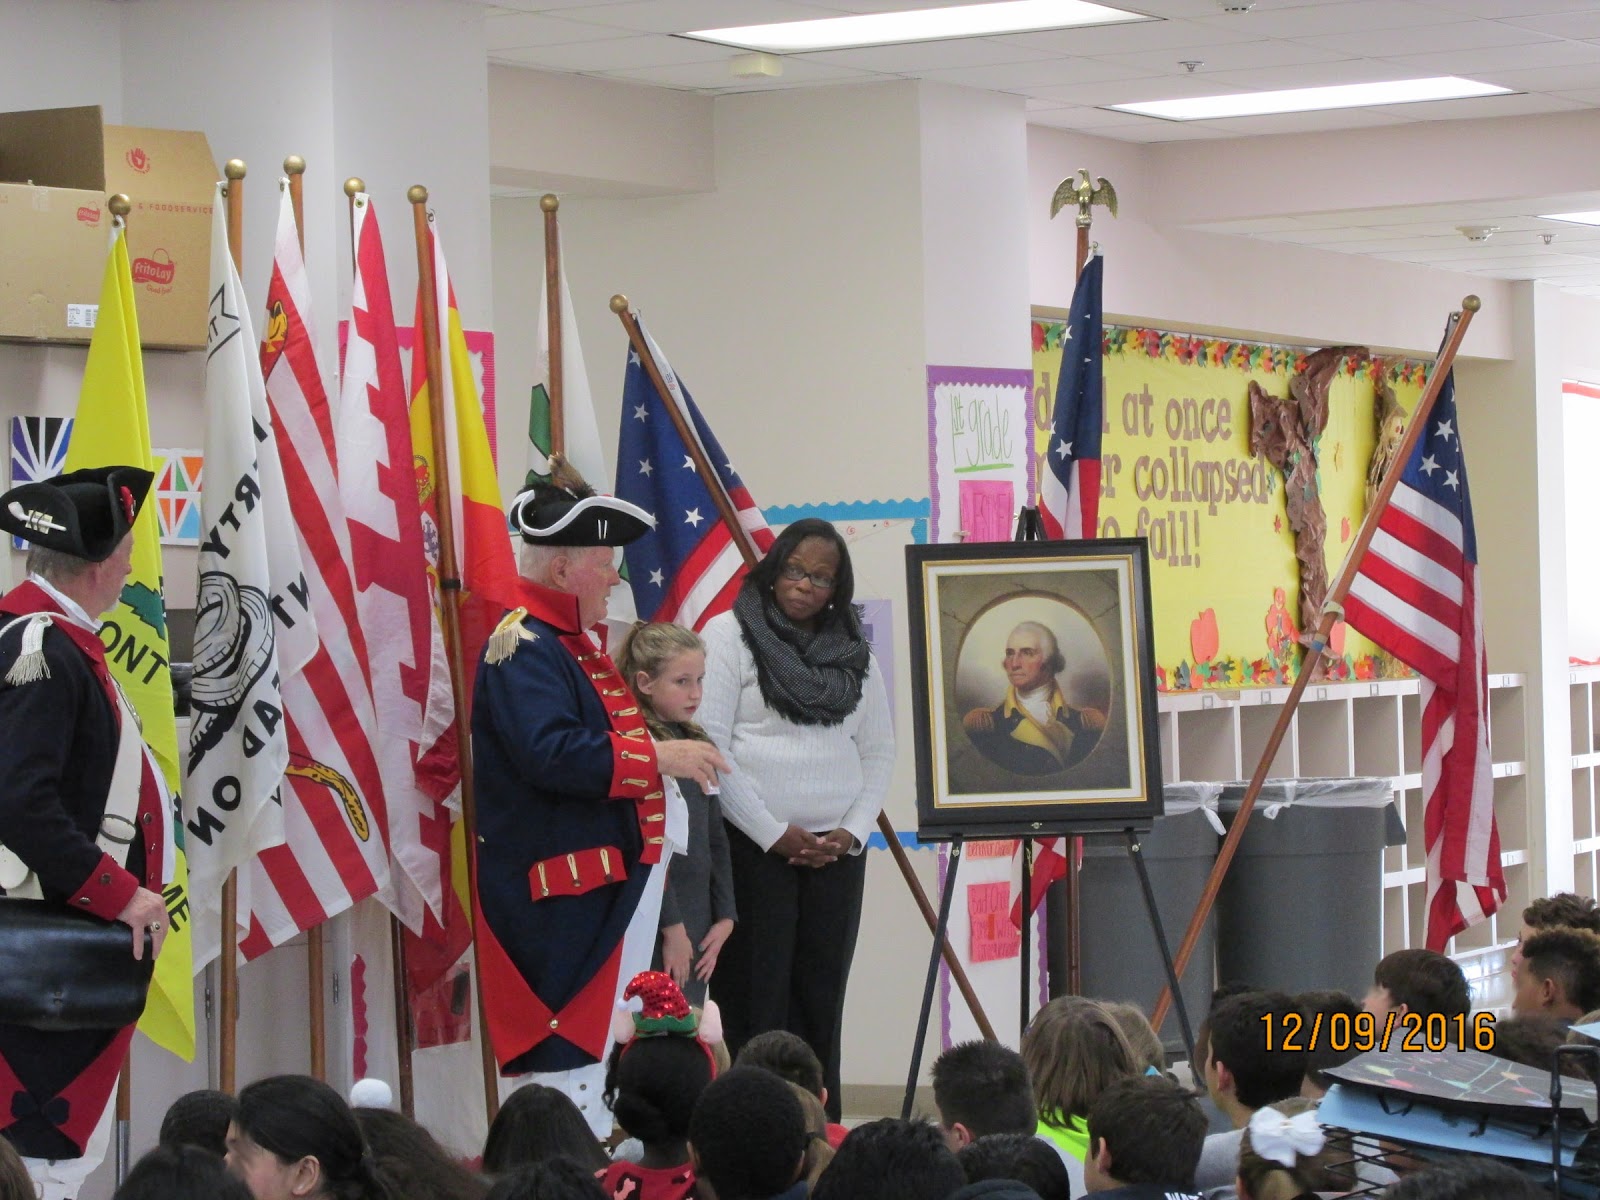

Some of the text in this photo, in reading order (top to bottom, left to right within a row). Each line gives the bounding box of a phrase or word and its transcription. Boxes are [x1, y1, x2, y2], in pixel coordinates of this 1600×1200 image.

[966, 393, 1013, 467] grade
[1122, 383, 1154, 437] at
[1166, 397, 1232, 443] once
[1135, 446, 1269, 517] collapsed
[1137, 506, 1201, 568] fall!
[98, 621, 168, 685] ONT
